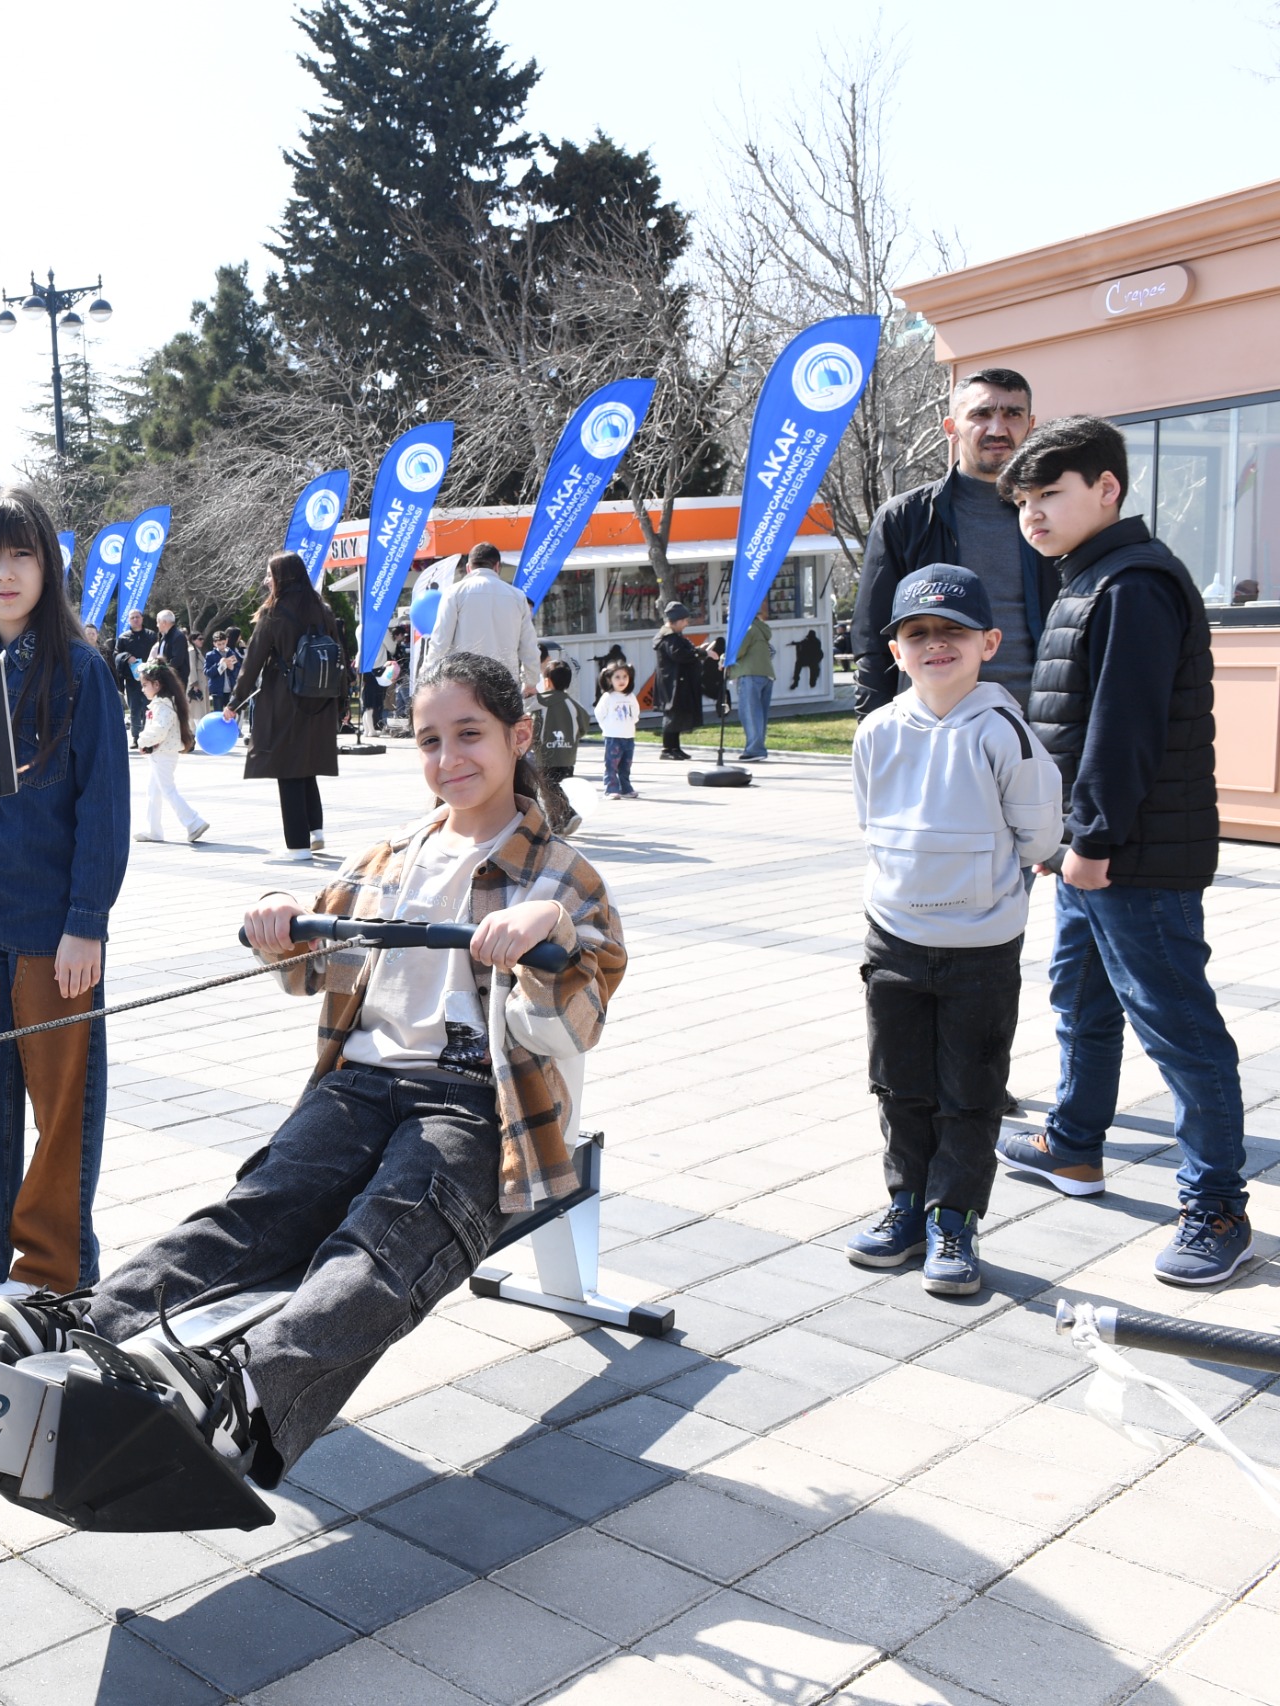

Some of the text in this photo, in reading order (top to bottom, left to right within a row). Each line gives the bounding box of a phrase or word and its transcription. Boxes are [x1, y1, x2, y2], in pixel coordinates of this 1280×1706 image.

[1105, 280, 1166, 314] Crepes
[757, 419, 800, 490] AKAF
[545, 463, 582, 520] AKAF
[744, 428, 816, 560] AZƏRBAYCAN KANOE VƏ
[331, 537, 358, 560] SKY
[377, 497, 404, 548] AKAF
[523, 517, 565, 576] AZƏRBAYCAN
[561, 486, 585, 517] KANOE
[747, 512, 786, 580] AVARÇƏKMƏ
[87, 567, 104, 598] AKAF
[124, 557, 141, 590] AKAF
[370, 545, 397, 598] AZƏRBAYCAN
[394, 517, 409, 545] KANOE
